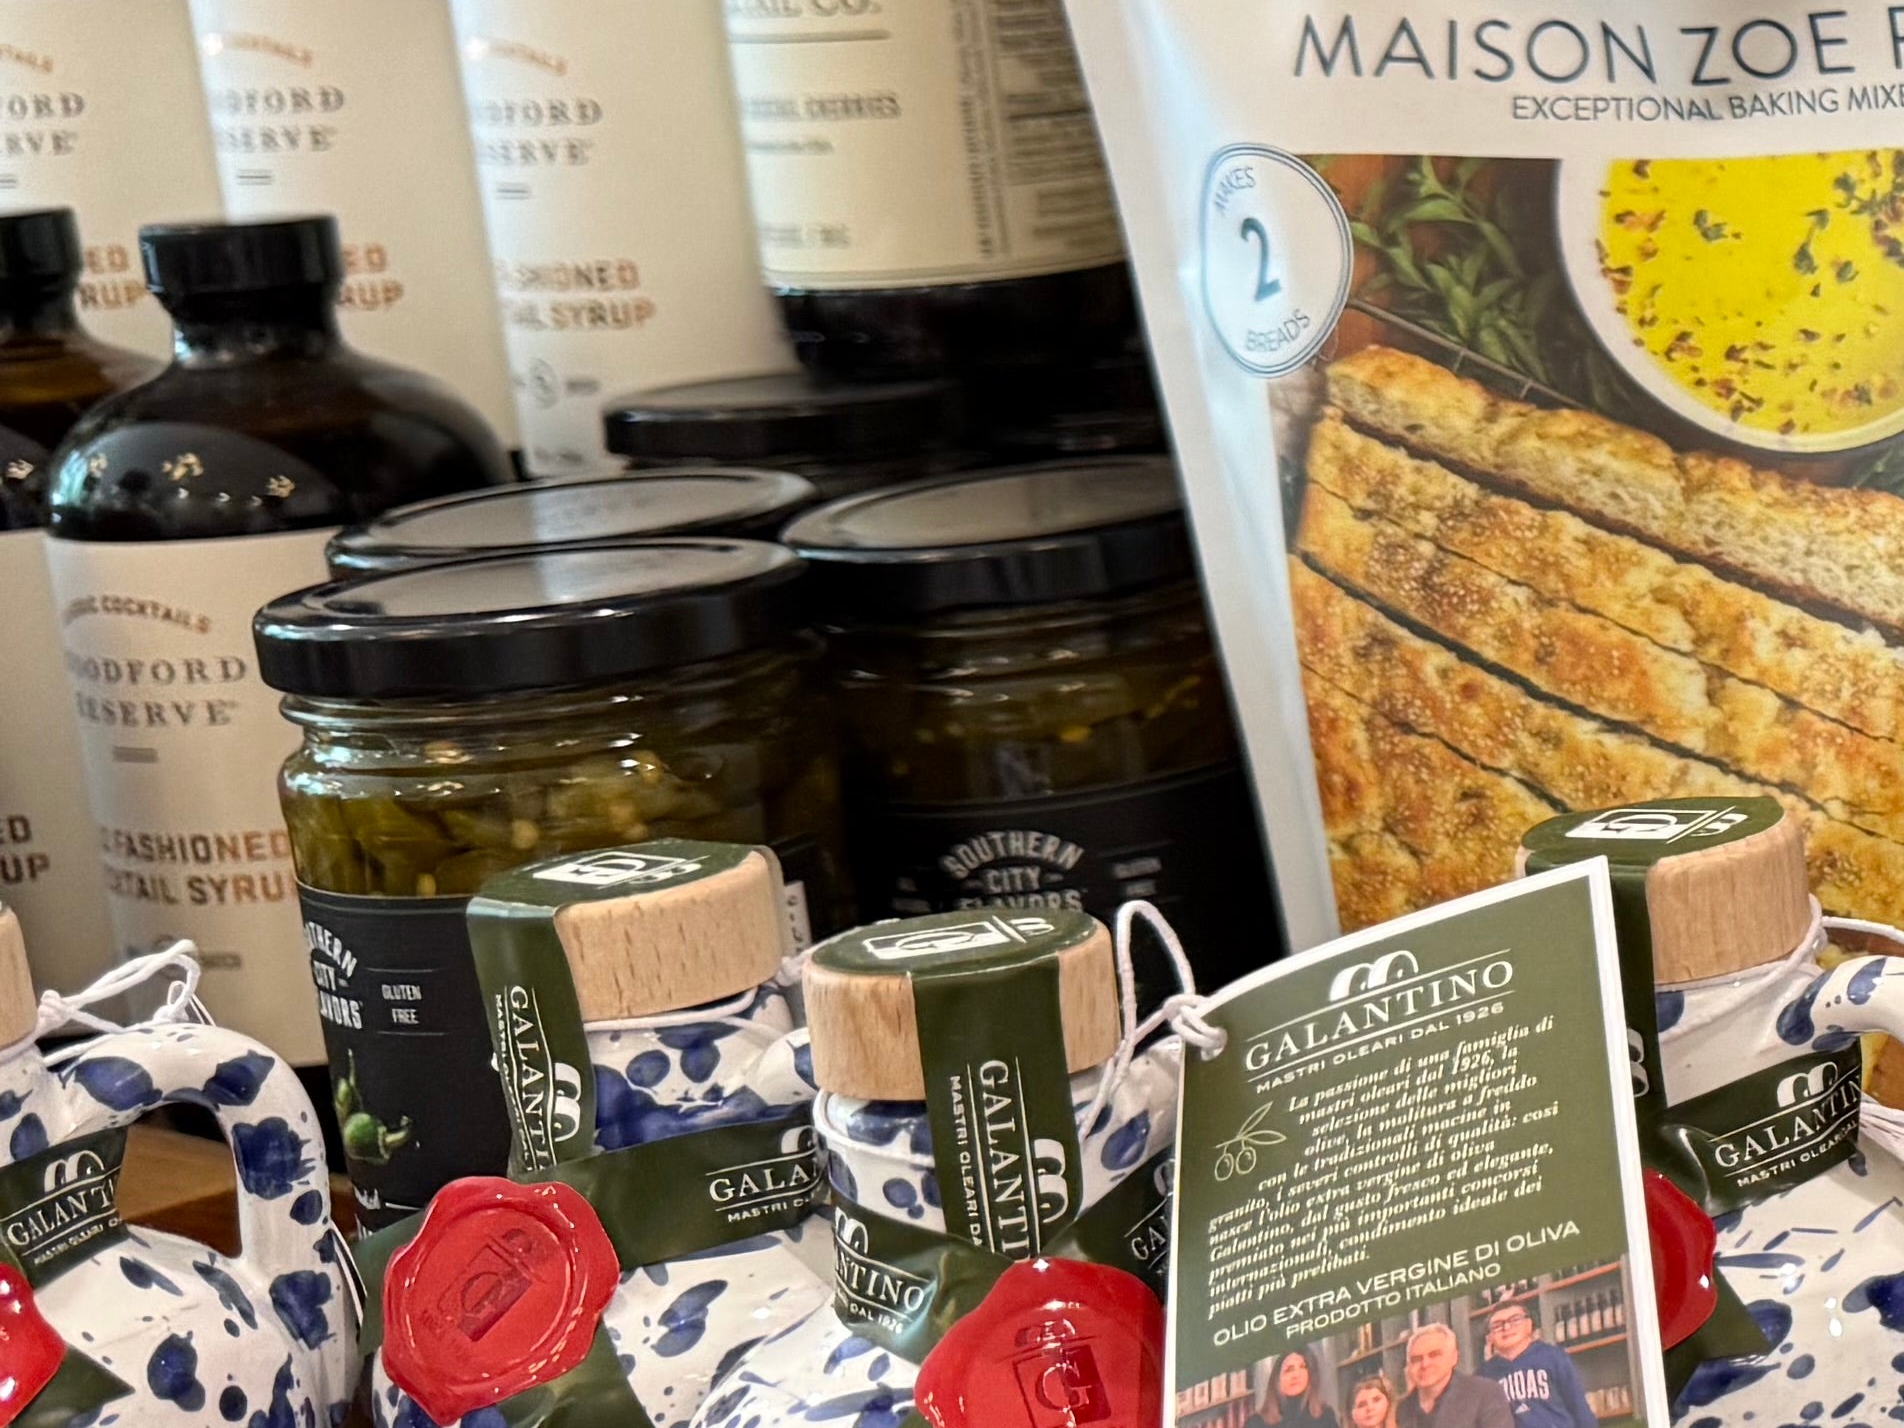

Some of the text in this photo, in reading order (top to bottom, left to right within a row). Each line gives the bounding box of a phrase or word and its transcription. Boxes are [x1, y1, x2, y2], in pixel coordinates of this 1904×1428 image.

[1291, 12, 1660, 87] MAISON
[1679, 9, 1854, 89] ZOE
[1511, 90, 1725, 123] EXCEPTIONAL
[1728, 86, 1840, 122] BAKING
[1239, 216, 1283, 302] 2
[1246, 307, 1312, 353] BREADS
[938, 830, 1085, 880] SOUTHERN
[984, 866, 1041, 894] CITY
[1245, 960, 1513, 1070] GALANTINO
[1255, 1001, 1504, 1094] MASTRI OLEARI DAL 1926
[949, 1075, 981, 1219] MASTRI OLEARI
[1713, 1074, 1862, 1169] GALANTIN
[977, 1058, 1030, 1264] GALANTI
[1736, 1158, 1795, 1187] MASTRI
[726, 1202, 789, 1224] MASTRI
[1212, 1219, 1580, 1346] OLIO EXTRA VERGINE DI OLIVA
[1285, 1262, 1501, 1339] PRODOTTO ITALIANO
[1499, 1368, 1551, 1402] IDAS
